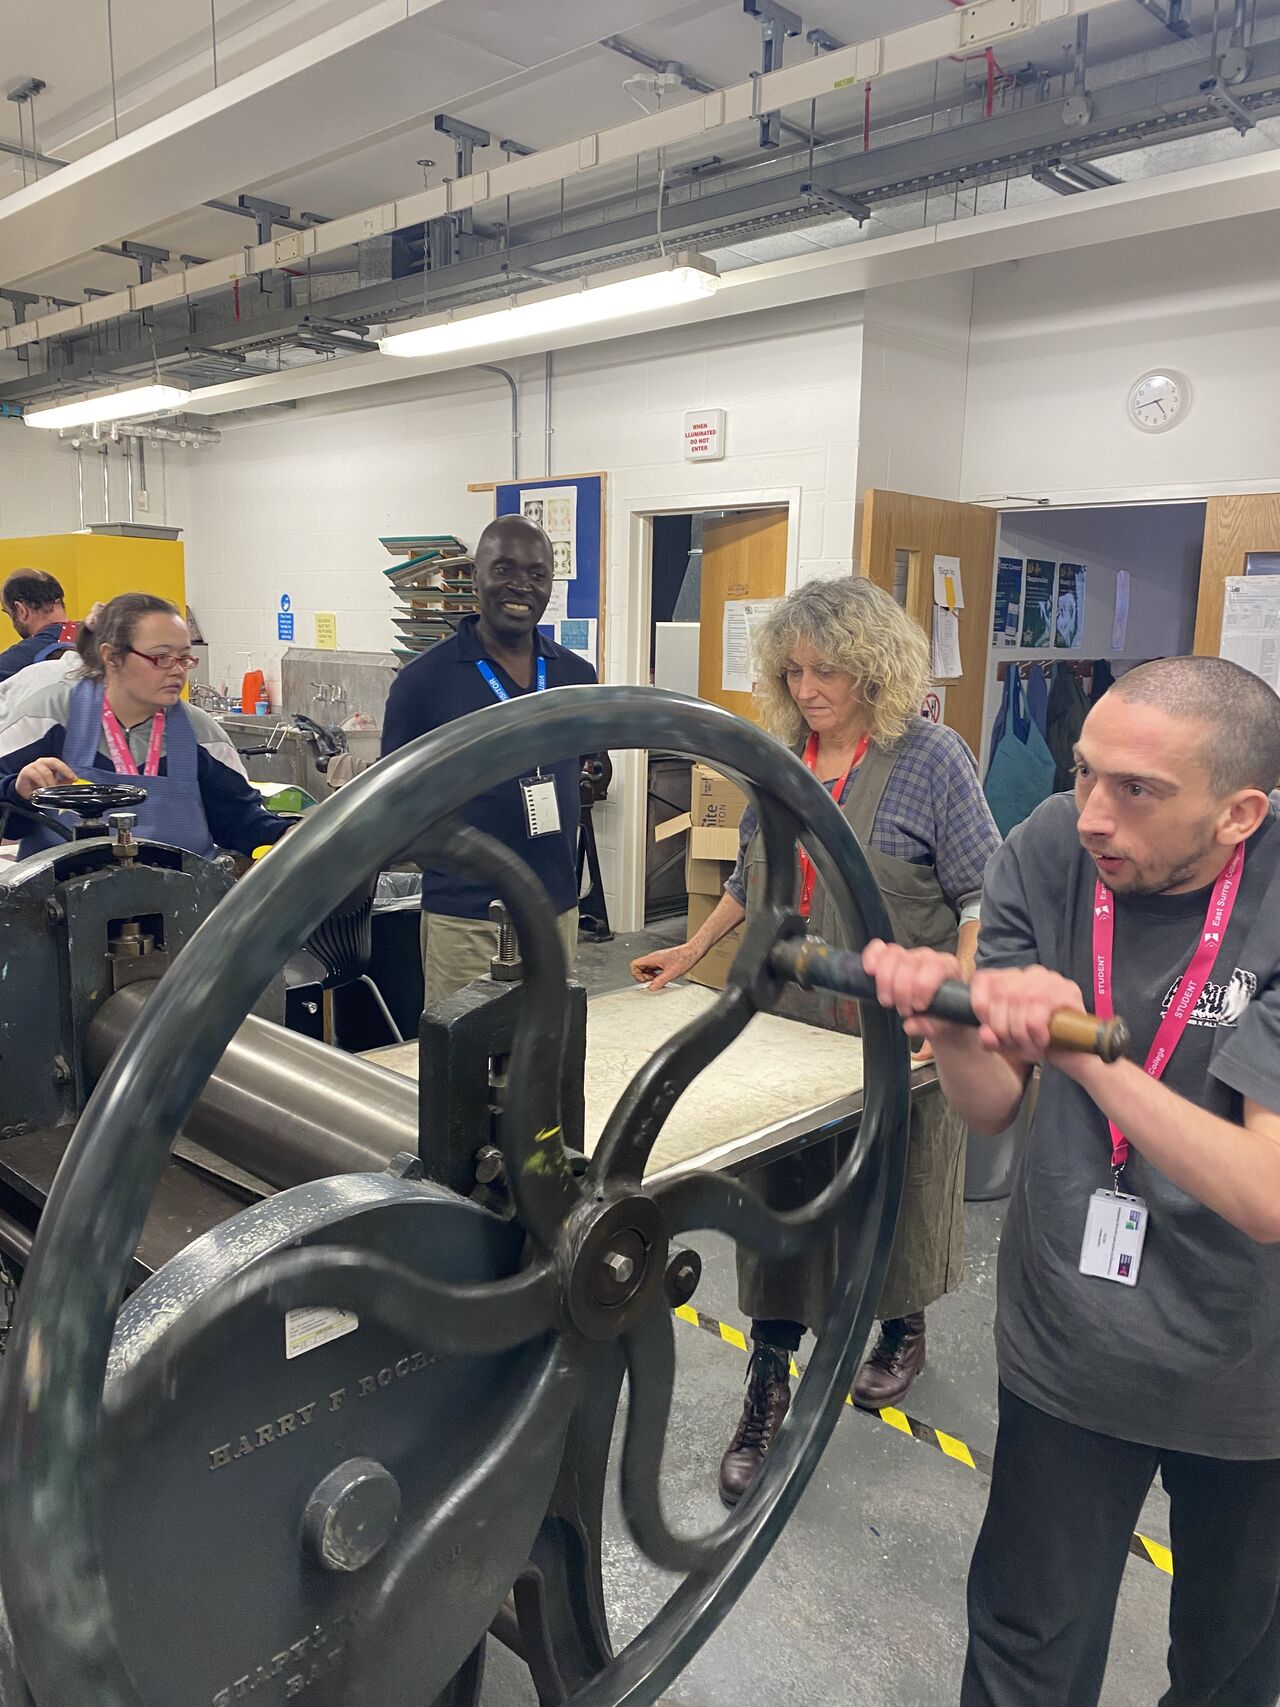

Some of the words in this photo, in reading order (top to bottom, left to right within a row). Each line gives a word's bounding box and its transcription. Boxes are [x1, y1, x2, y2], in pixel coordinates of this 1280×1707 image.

[938, 566, 950, 577] Sign
[1216, 880, 1233, 907] Surrey
[1212, 908, 1224, 927] East
[1174, 980, 1198, 1019] STUDENT
[1148, 1047, 1165, 1075] College
[209, 1402, 317, 1470] HARRY
[329, 1388, 346, 1412] F
